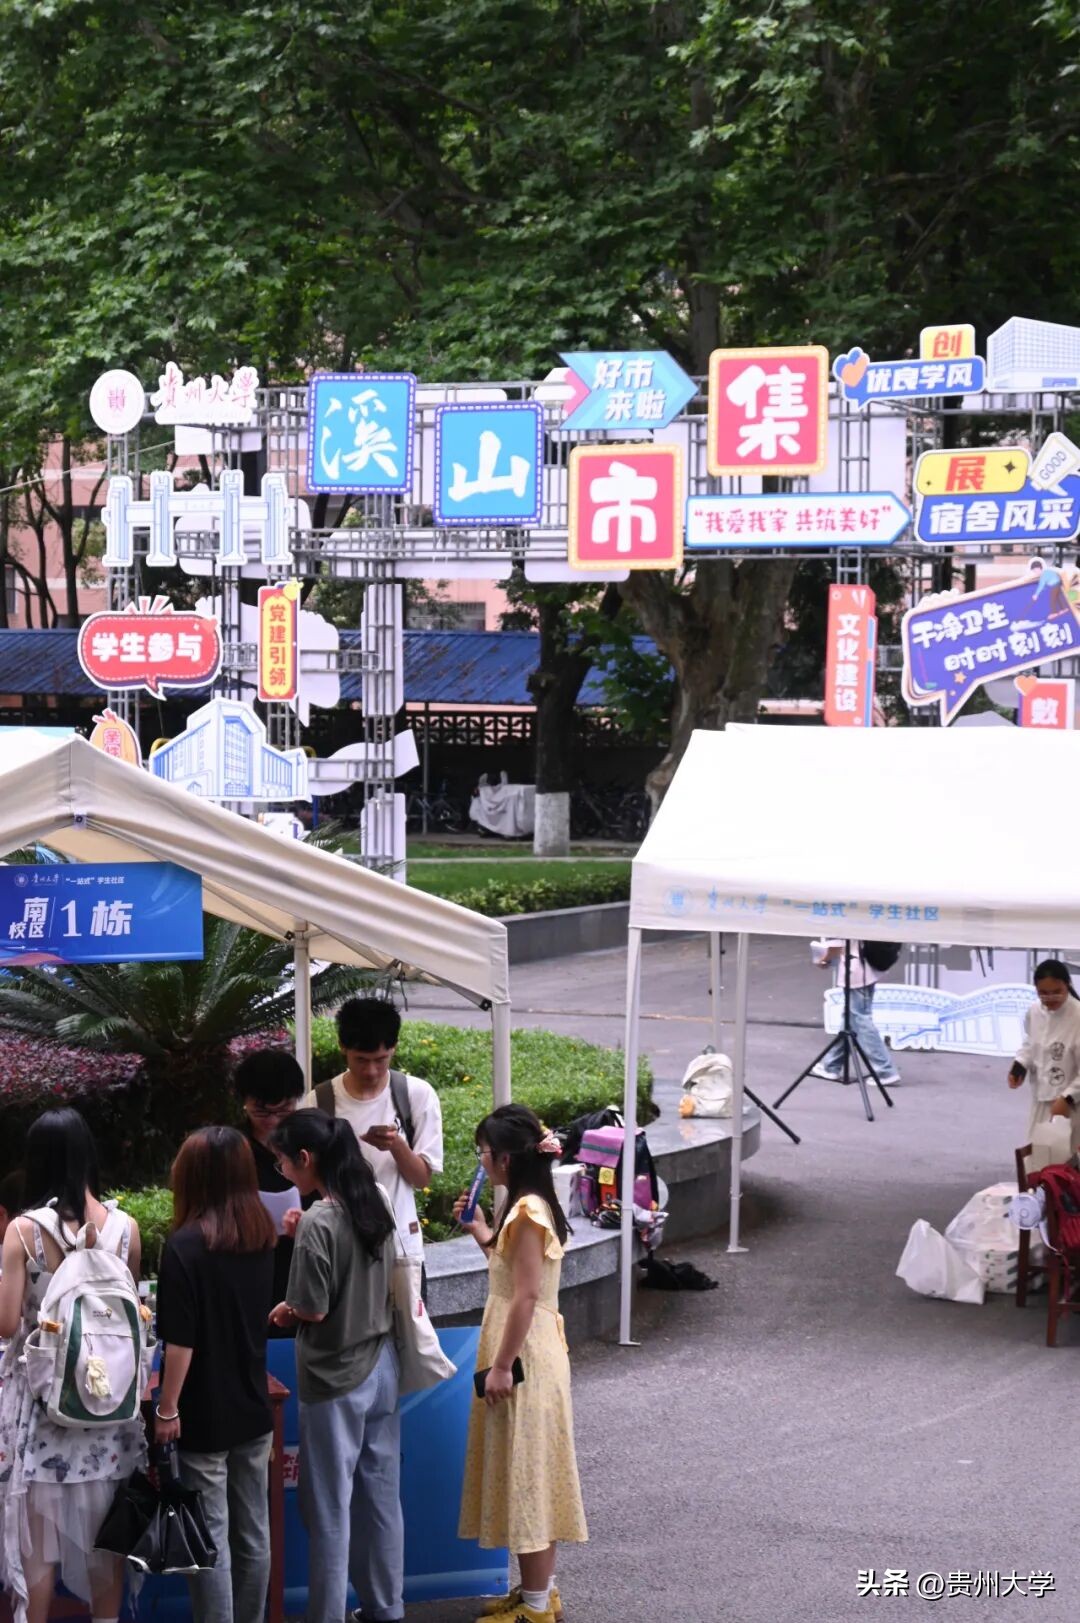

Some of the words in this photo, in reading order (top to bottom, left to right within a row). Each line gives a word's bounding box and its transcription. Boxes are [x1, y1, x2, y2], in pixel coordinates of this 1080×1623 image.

[932, 331, 963, 358] 创
[592, 357, 653, 390] 好市
[866, 363, 973, 393] 优良学风
[604, 390, 666, 421] 来啦
[726, 364, 809, 460] 集
[319, 388, 399, 480] 溪
[448, 430, 530, 501] 山
[945, 456, 986, 491] 展
[1039, 450, 1068, 482] GOOD
[589, 461, 658, 553] 市
[929, 497, 1075, 535] 宿舍风采
[911, 602, 1009, 649] 干净卫生
[92, 632, 203, 662] 学生参与
[269, 604, 286, 686] 党建引领
[943, 622, 1073, 672] 时时刻刻
[834, 614, 860, 712] 文化建设
[97, 876, 125, 884] 学生社区
[23, 897, 49, 922] 南
[869, 904, 940, 922] 学生社区
[8, 921, 45, 939] 校区
